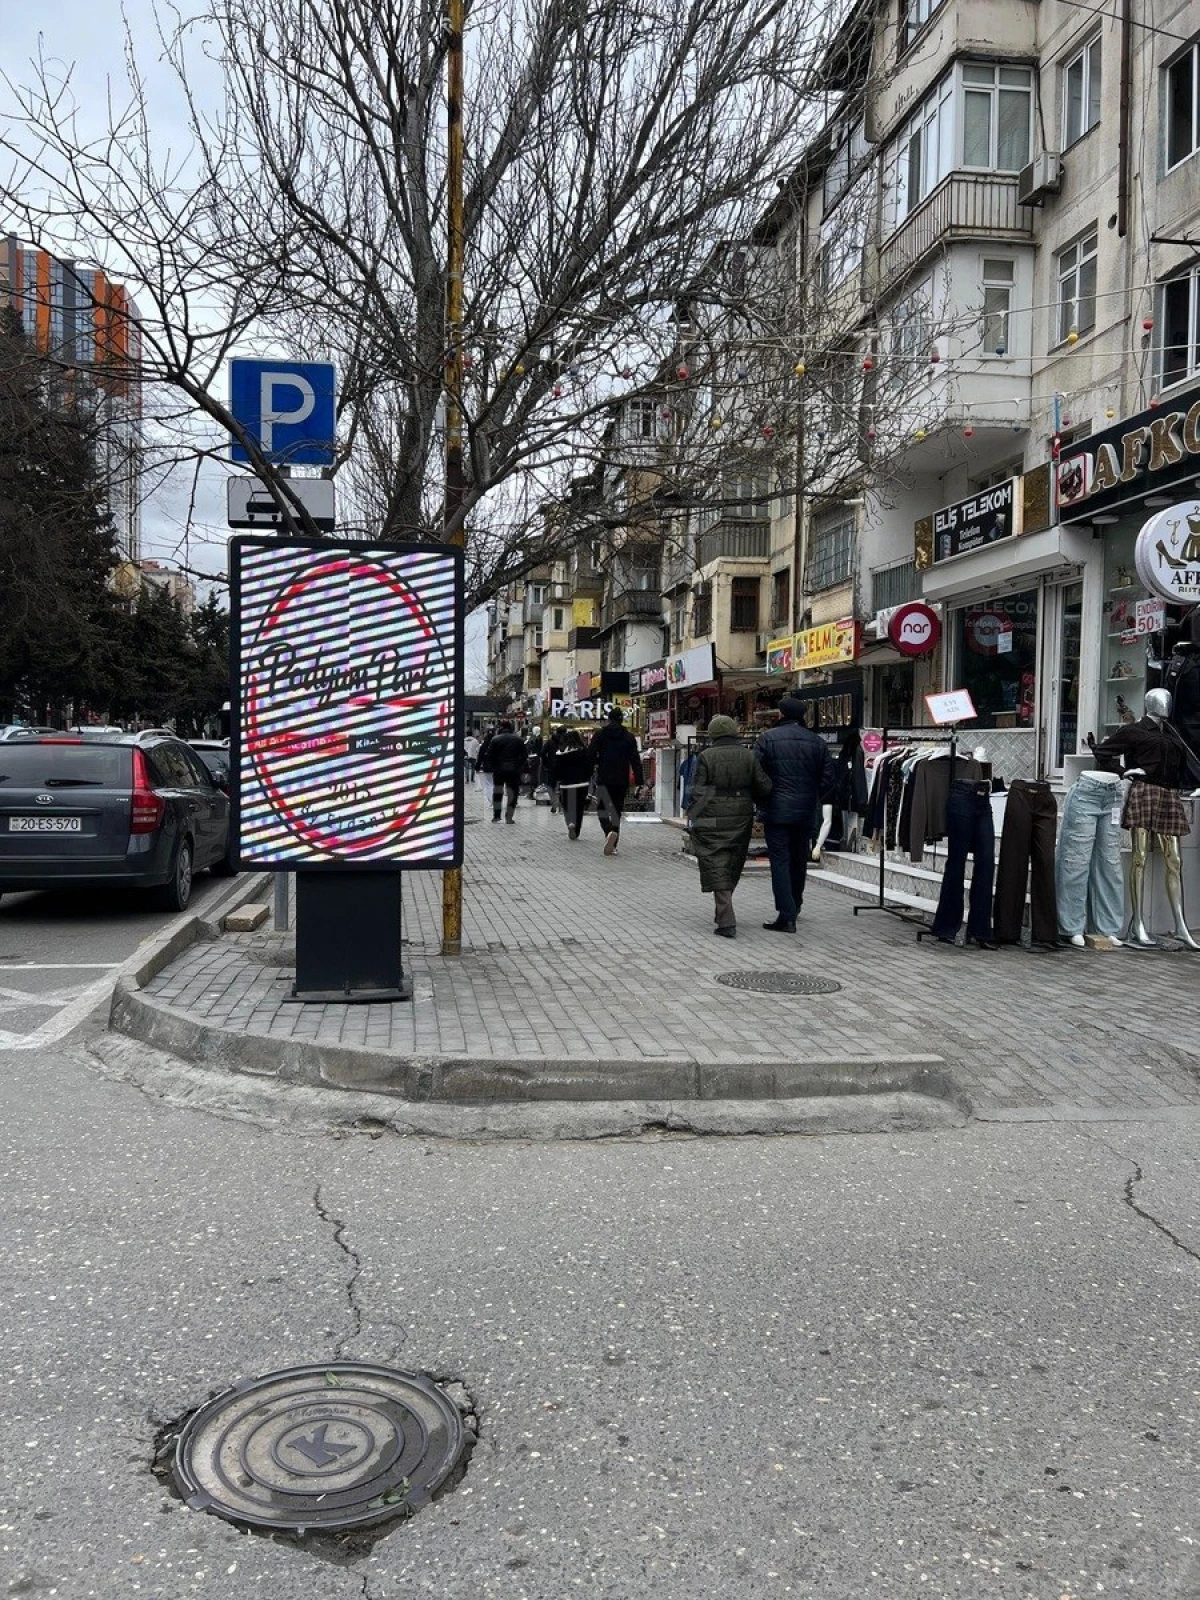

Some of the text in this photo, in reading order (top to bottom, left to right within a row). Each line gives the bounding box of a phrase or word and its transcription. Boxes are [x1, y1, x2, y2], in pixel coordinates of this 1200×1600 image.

[260, 372, 315, 452] P
[961, 485, 1012, 522] TELEKOM
[903, 623, 929, 634] nar
[286, 1423, 357, 1468] K
